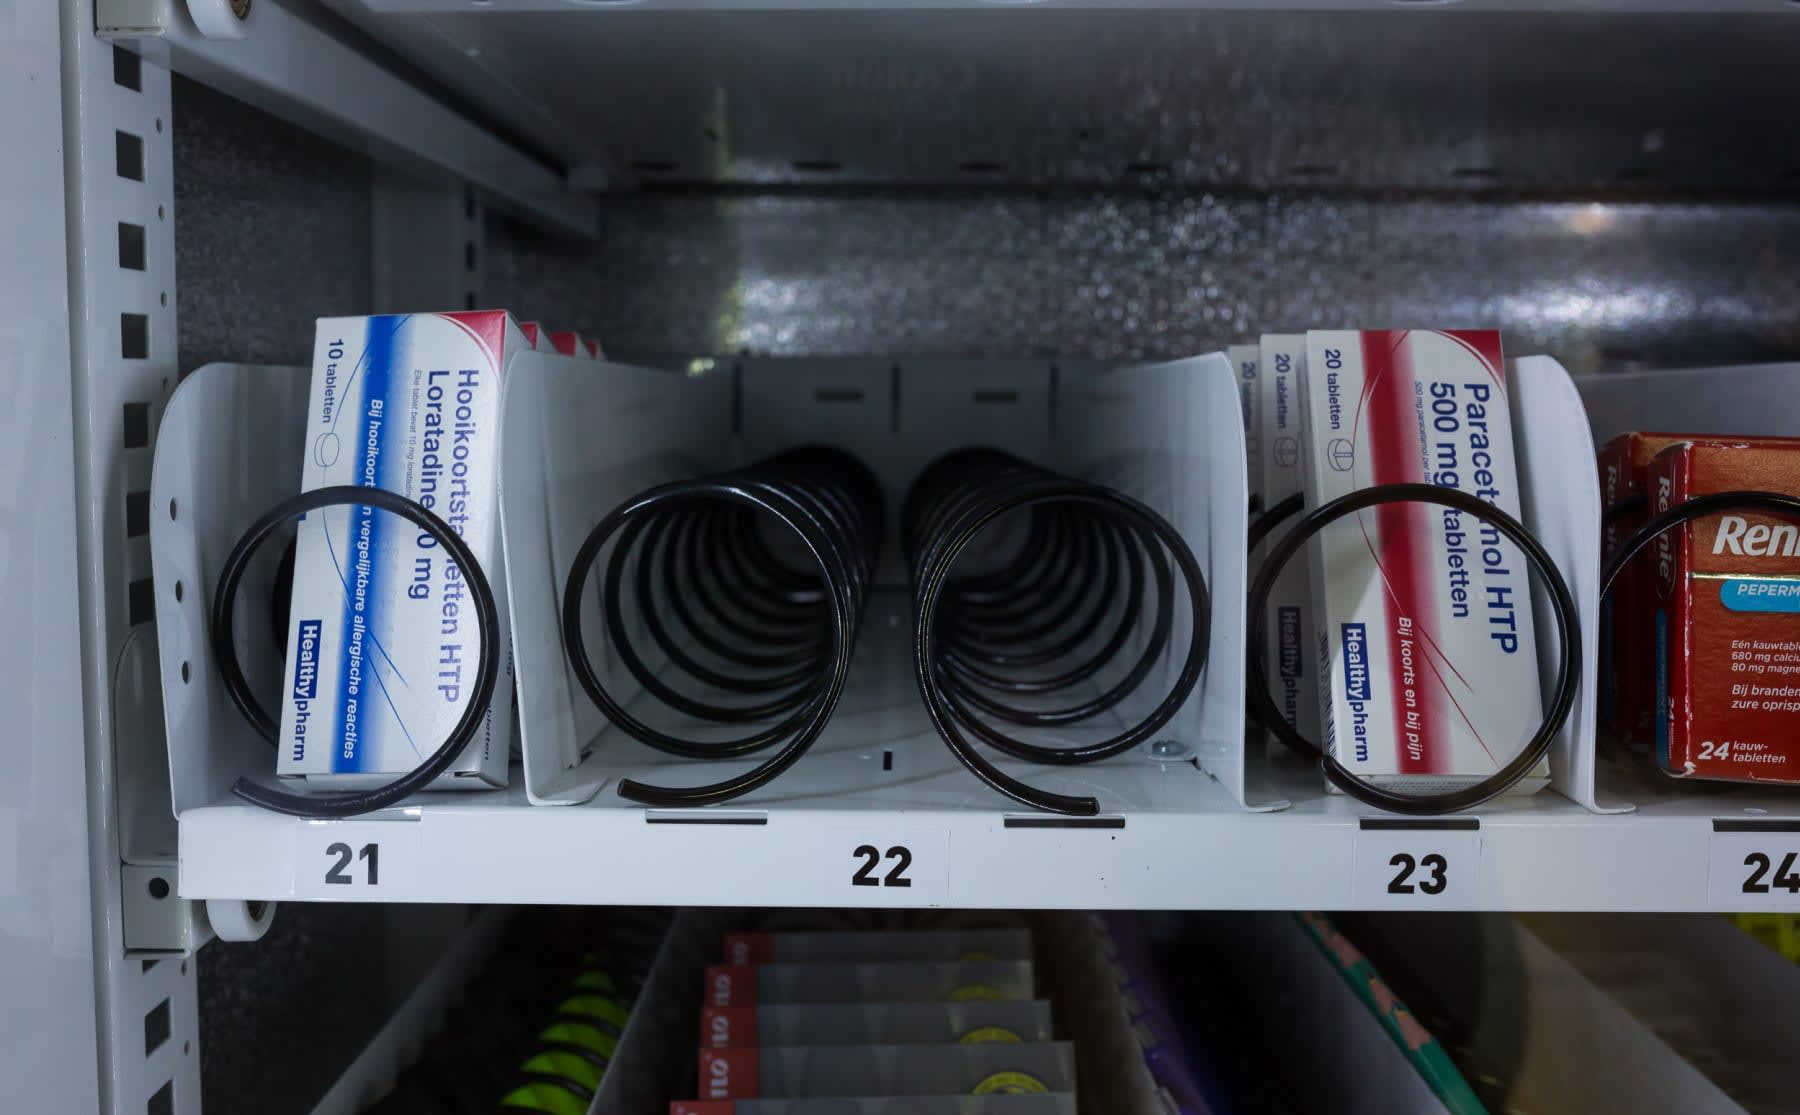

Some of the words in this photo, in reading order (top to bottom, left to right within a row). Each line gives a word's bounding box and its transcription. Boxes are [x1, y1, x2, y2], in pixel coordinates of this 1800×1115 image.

[328, 339, 344, 359] 10
[1275, 354, 1290, 372] 20
[1325, 349, 1341, 369] 20
[1242, 361, 1256, 379] 20
[322, 364, 339, 423] tabletten
[368, 399, 383, 417] Bij
[1276, 376, 1288, 429] tabletten
[1327, 373, 1340, 429] tabletten
[1430, 382, 1459, 431] 500
[364, 421, 381, 487] hooikoort
[419, 370, 450, 508] Loratadine
[1433, 442, 1460, 490] mg
[1464, 383, 1509, 574] Paracetmol
[441, 370, 479, 634] Hooikoortstaetten
[355, 520, 371, 610] vergelijkbare
[407, 558, 432, 599] mg
[1442, 509, 1470, 618] tabletten
[1398, 617, 1411, 637] Bij
[1486, 586, 1518, 654] HTP
[348, 615, 366, 695] allergische
[1400, 640, 1415, 684] koorts
[1731, 651, 1752, 661] 680
[1754, 652, 1771, 664] mg
[1753, 640, 1800, 651] kauwtabl
[438, 645, 462, 702] HTP
[1731, 662, 1746, 672] 80
[1748, 664, 1765, 674] mg
[293, 624, 318, 761] Healthypharm
[1347, 627, 1369, 762] Healthypharm
[1404, 690, 1416, 707] en
[1731, 684, 1749, 698] Bij
[1731, 700, 1759, 709] zure
[343, 698, 361, 758] reacties
[1405, 712, 1420, 729] bij
[1405, 732, 1422, 760] pijn
[1697, 741, 1730, 760] 24
[1733, 741, 1769, 751] kauw-
[1733, 754, 1786, 763] tabletten
[325, 843, 378, 885] 21
[852, 845, 911, 888] 22
[1387, 853, 1447, 894] 23
[1742, 852, 1800, 893] 24
